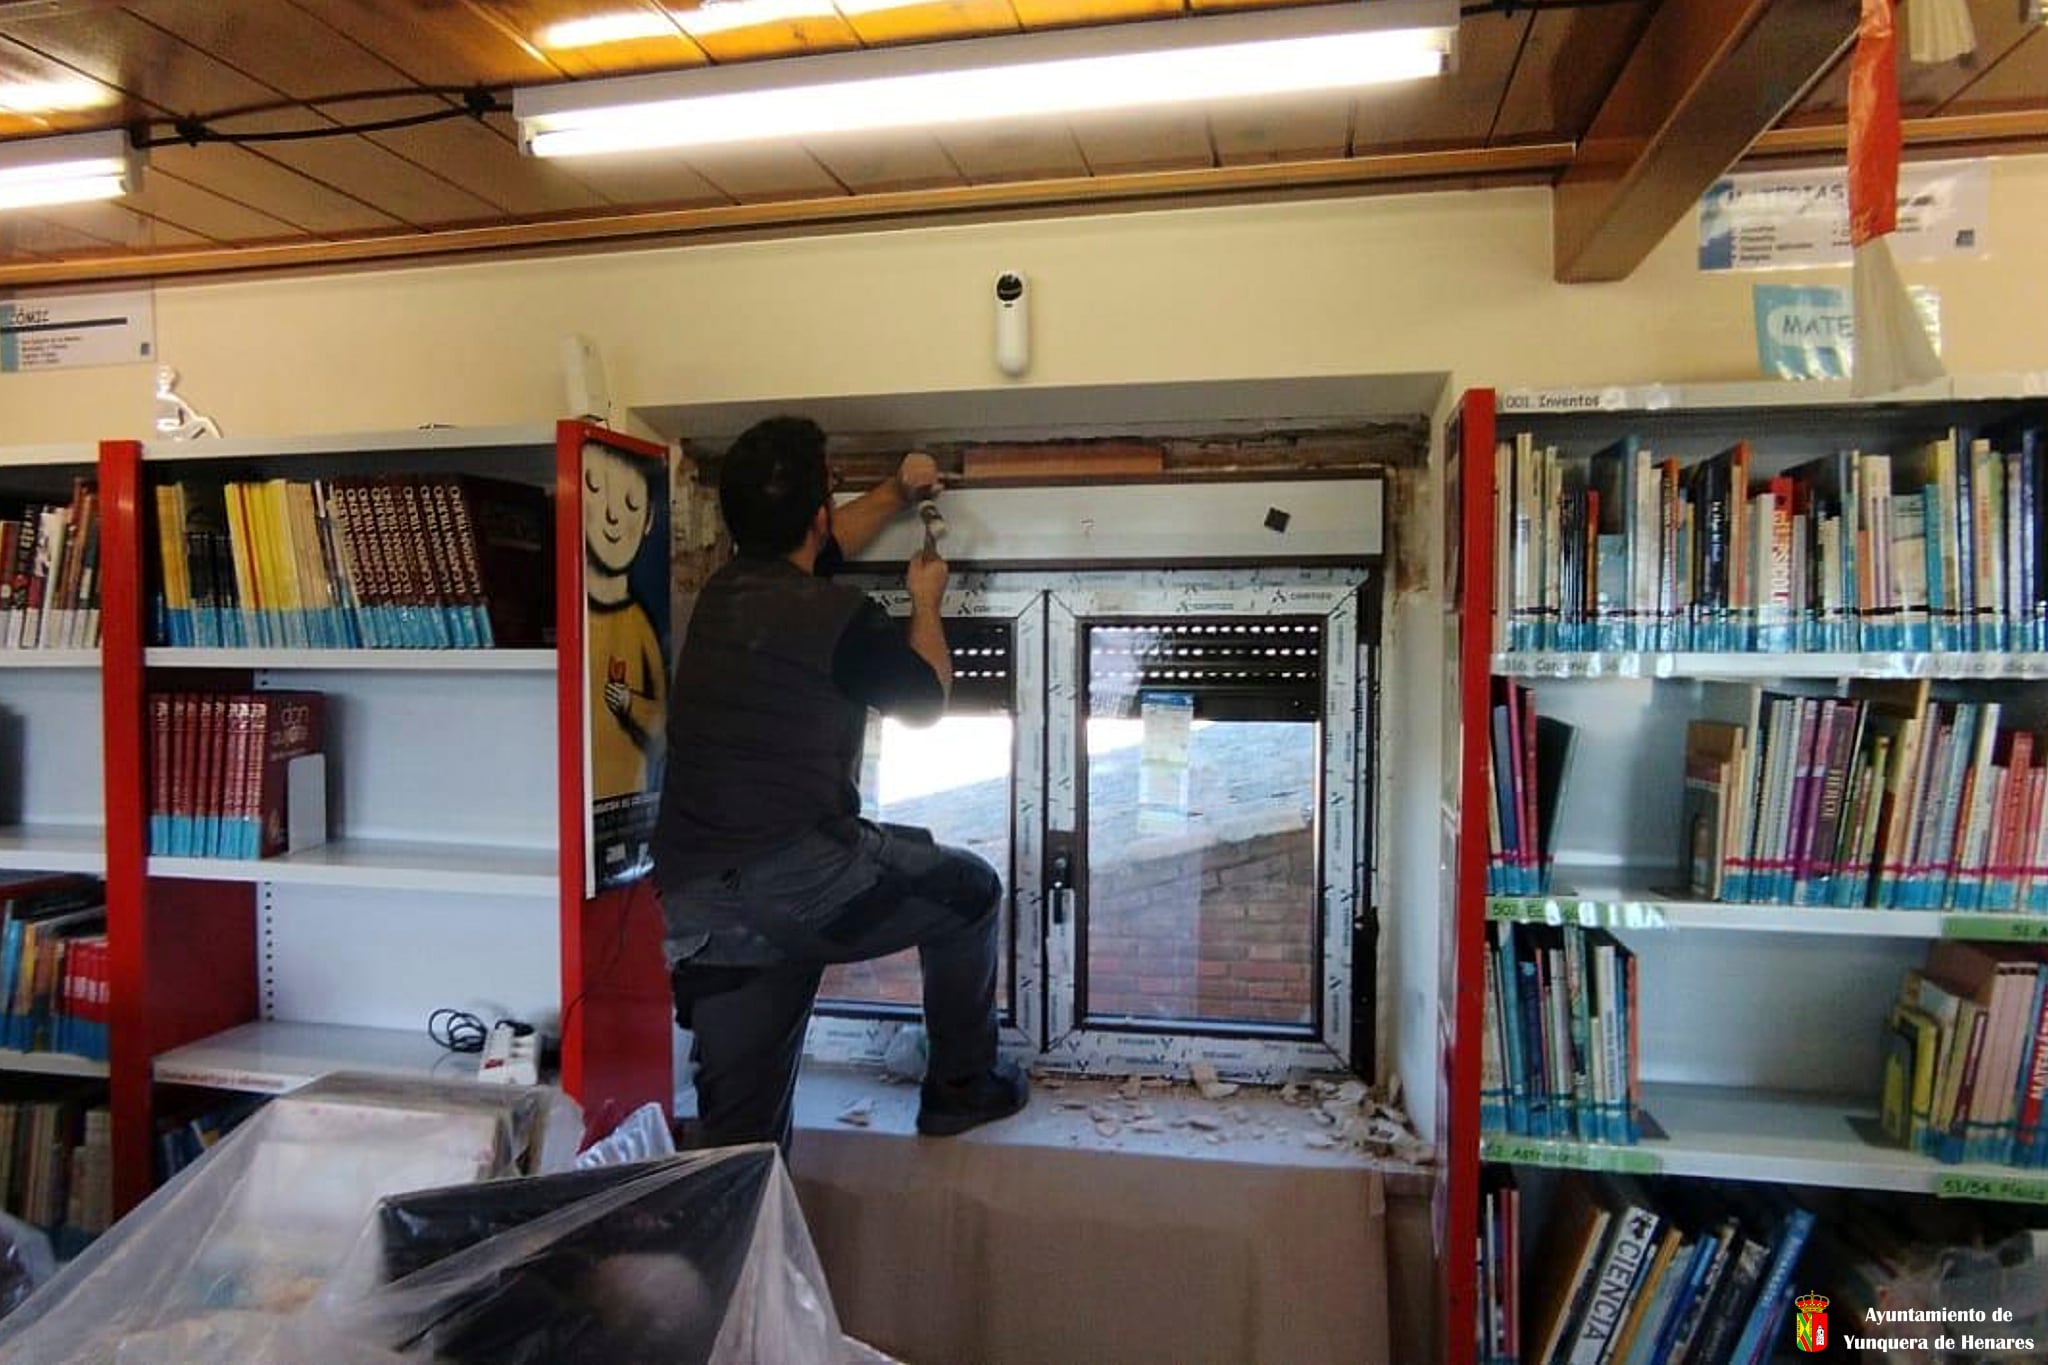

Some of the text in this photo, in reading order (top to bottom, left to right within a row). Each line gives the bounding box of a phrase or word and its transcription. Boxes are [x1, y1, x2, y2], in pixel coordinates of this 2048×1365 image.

[1781, 314, 1854, 338] MATE
[1539, 393, 1600, 409] Inventos
[1583, 1240, 1642, 1340] CIENCIA
